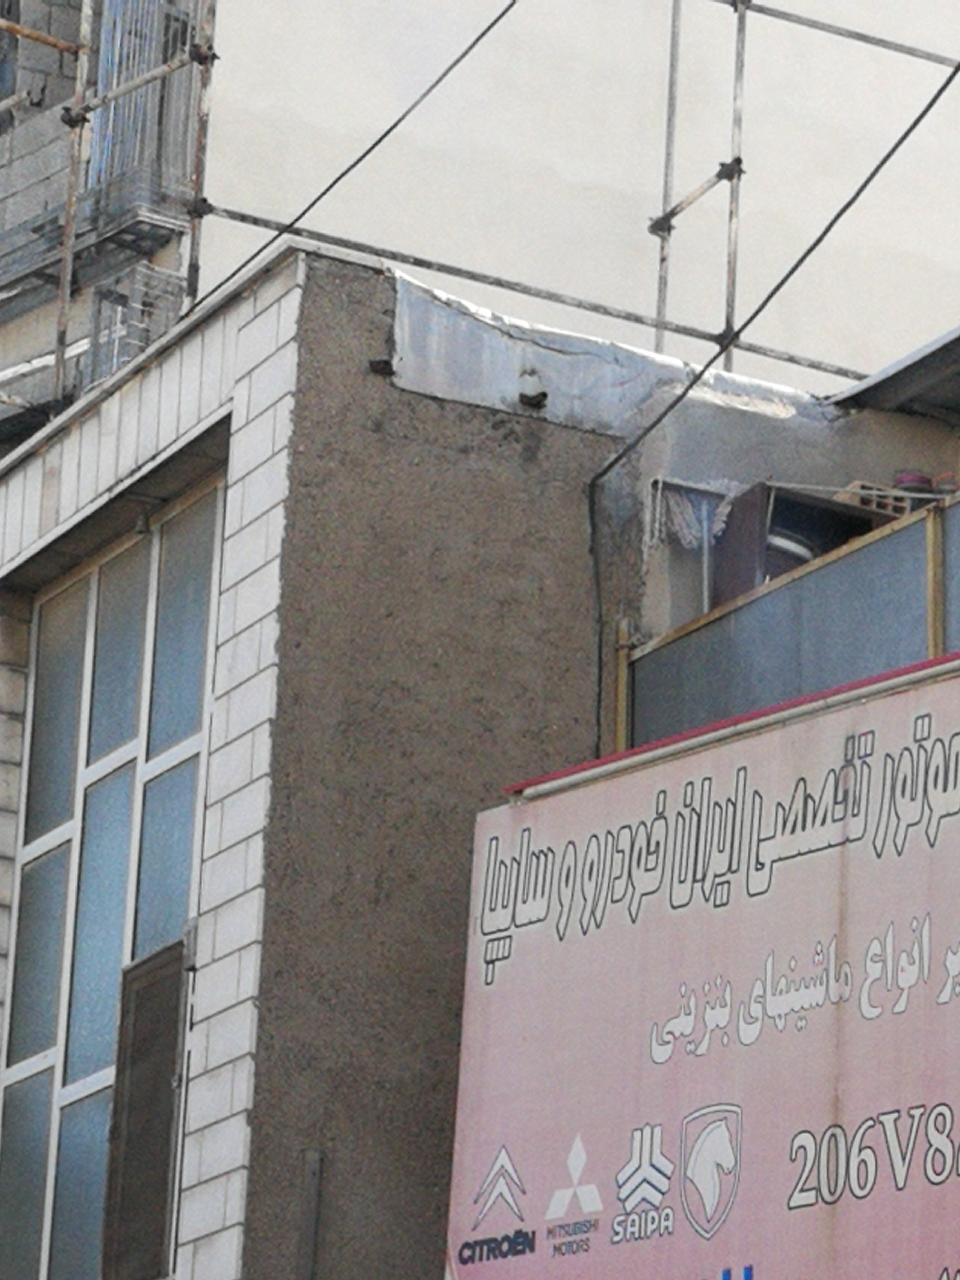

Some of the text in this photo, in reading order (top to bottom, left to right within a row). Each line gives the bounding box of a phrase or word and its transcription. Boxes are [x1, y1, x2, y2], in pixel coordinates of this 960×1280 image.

[579, 789, 669, 937] خودرو
[668, 765, 748, 910] ایران
[746, 729, 875, 898] تخصصی
[480, 827, 556, 986] سایپا
[556, 840, 578, 942] و
[649, 973, 733, 1066] بنزینی
[736, 933, 852, 1046] ماشینهای
[859, 911, 932, 1022] انواع
[457, 1228, 537, 1266] CITROËN
[551, 1237, 591, 1258] MOTORS
[610, 1205, 675, 1245] SAIPA
